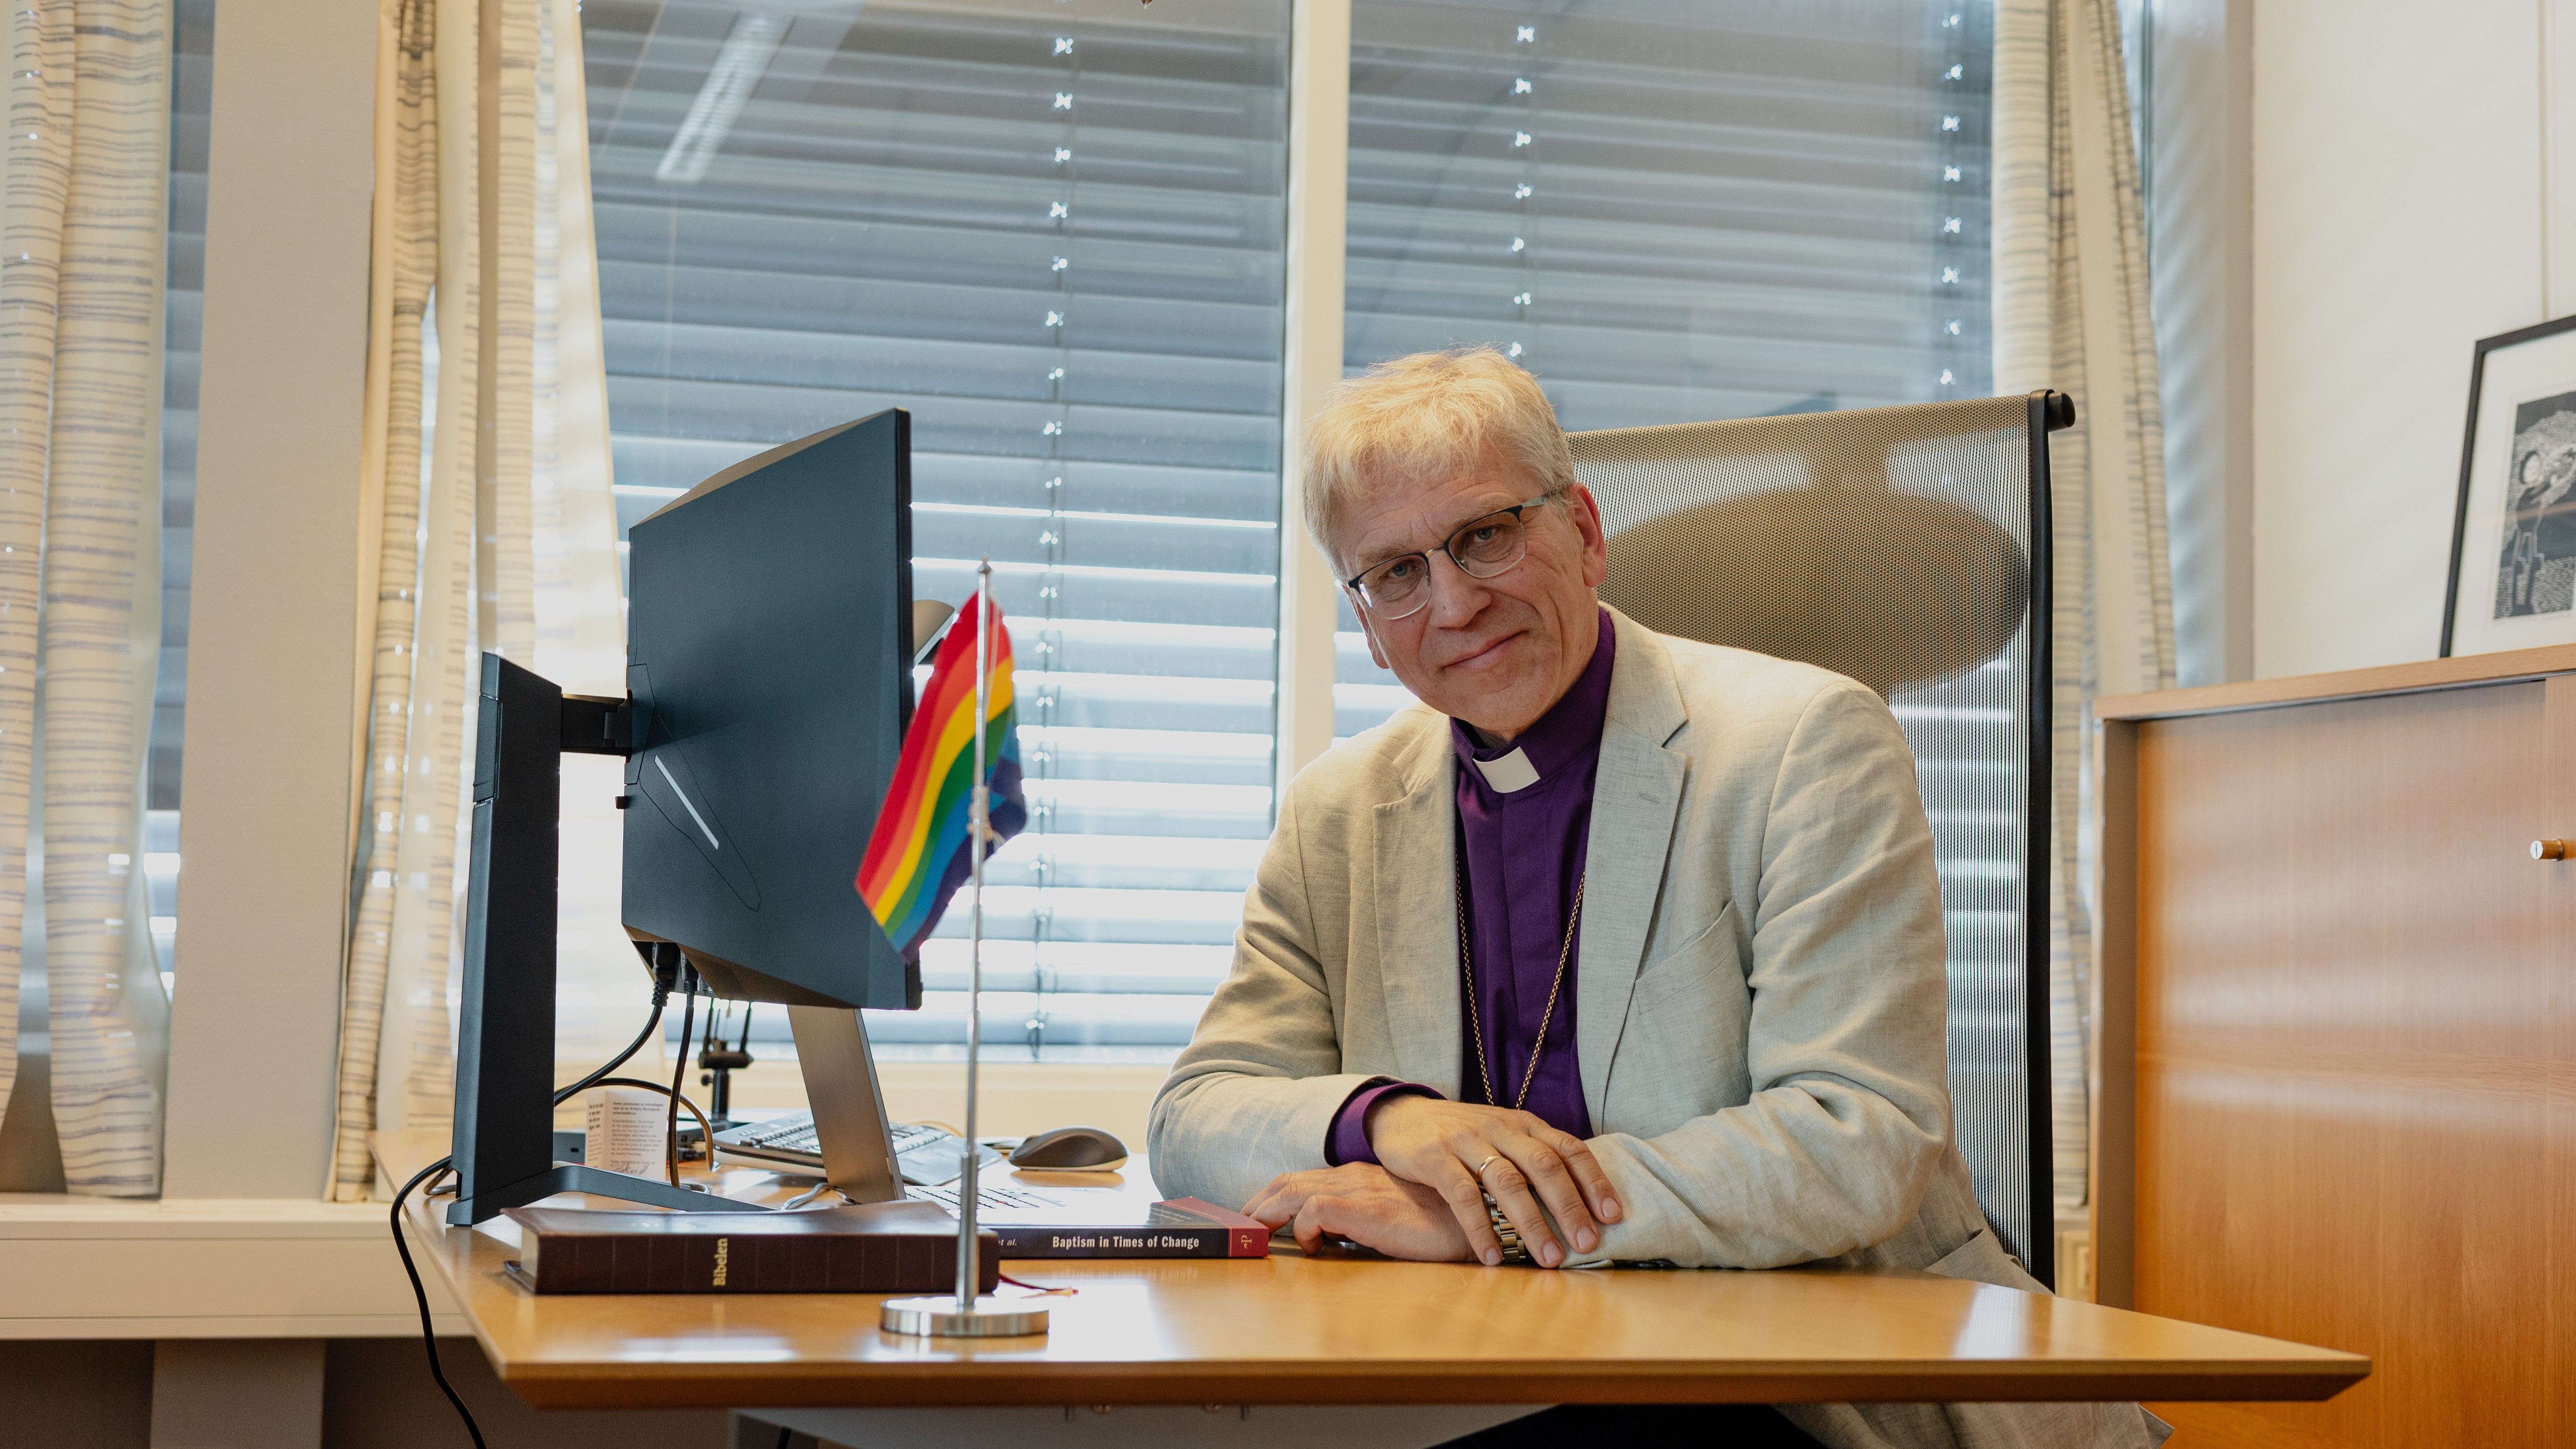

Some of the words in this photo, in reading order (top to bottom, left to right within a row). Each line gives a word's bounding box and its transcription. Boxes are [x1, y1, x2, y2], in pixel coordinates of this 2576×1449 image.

[1053, 1236, 1095, 1250] Baptism
[1099, 1236, 1109, 1248] in
[1113, 1236, 1143, 1248] Times
[1147, 1235, 1158, 1248] of
[1161, 1236, 1199, 1250] Change
[713, 1237, 727, 1287] Bibelen
